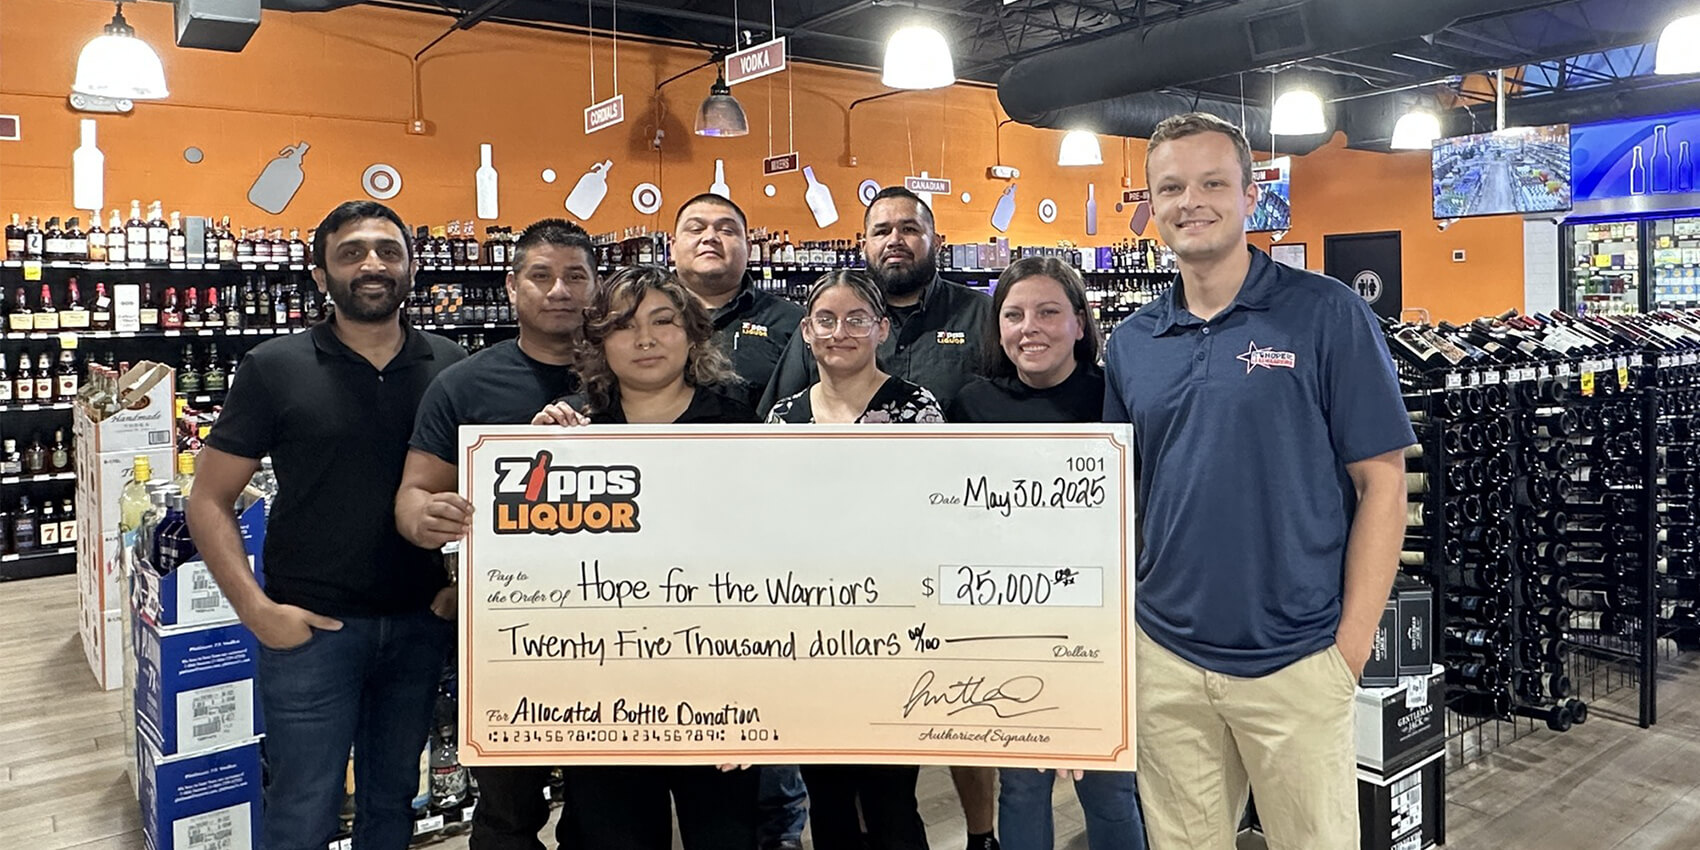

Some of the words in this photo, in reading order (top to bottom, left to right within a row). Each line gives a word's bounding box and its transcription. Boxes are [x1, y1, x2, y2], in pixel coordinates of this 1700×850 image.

[739, 51, 770, 75] VODKA
[911, 180, 945, 191] CANADIAN
[111, 411, 161, 423] Handmade
[1066, 457, 1105, 472] 1001
[499, 454, 636, 502] Zipps
[929, 493, 961, 505] Date
[964, 476, 1012, 517] May
[1050, 475, 1106, 510] 2025
[498, 502, 635, 530] LIQUOR
[45, 528, 55, 541] 7
[64, 526, 74, 539] 7
[487, 569, 514, 588] Pay
[516, 570, 529, 582] to
[577, 560, 650, 608] Hope
[659, 567, 699, 603] for
[708, 572, 759, 604] the
[765, 571, 879, 607] Warriors
[922, 576, 935, 598] $
[487, 590, 507, 604] the
[509, 589, 547, 604] Order
[549, 589, 572, 607] Of
[498, 623, 605, 666] Twenty
[614, 626, 672, 659] Five
[673, 625, 797, 661] Thousand
[809, 629, 901, 658] dollars
[1052, 645, 1101, 659] Dollars
[486, 709, 509, 723] For
[510, 696, 601, 725] Allocated
[613, 698, 669, 725] Bottle
[677, 700, 760, 726] Donation
[1397, 703, 1434, 728] GENTLEMAN
[918, 727, 993, 743] Authorized
[990, 729, 1051, 748] Signature
